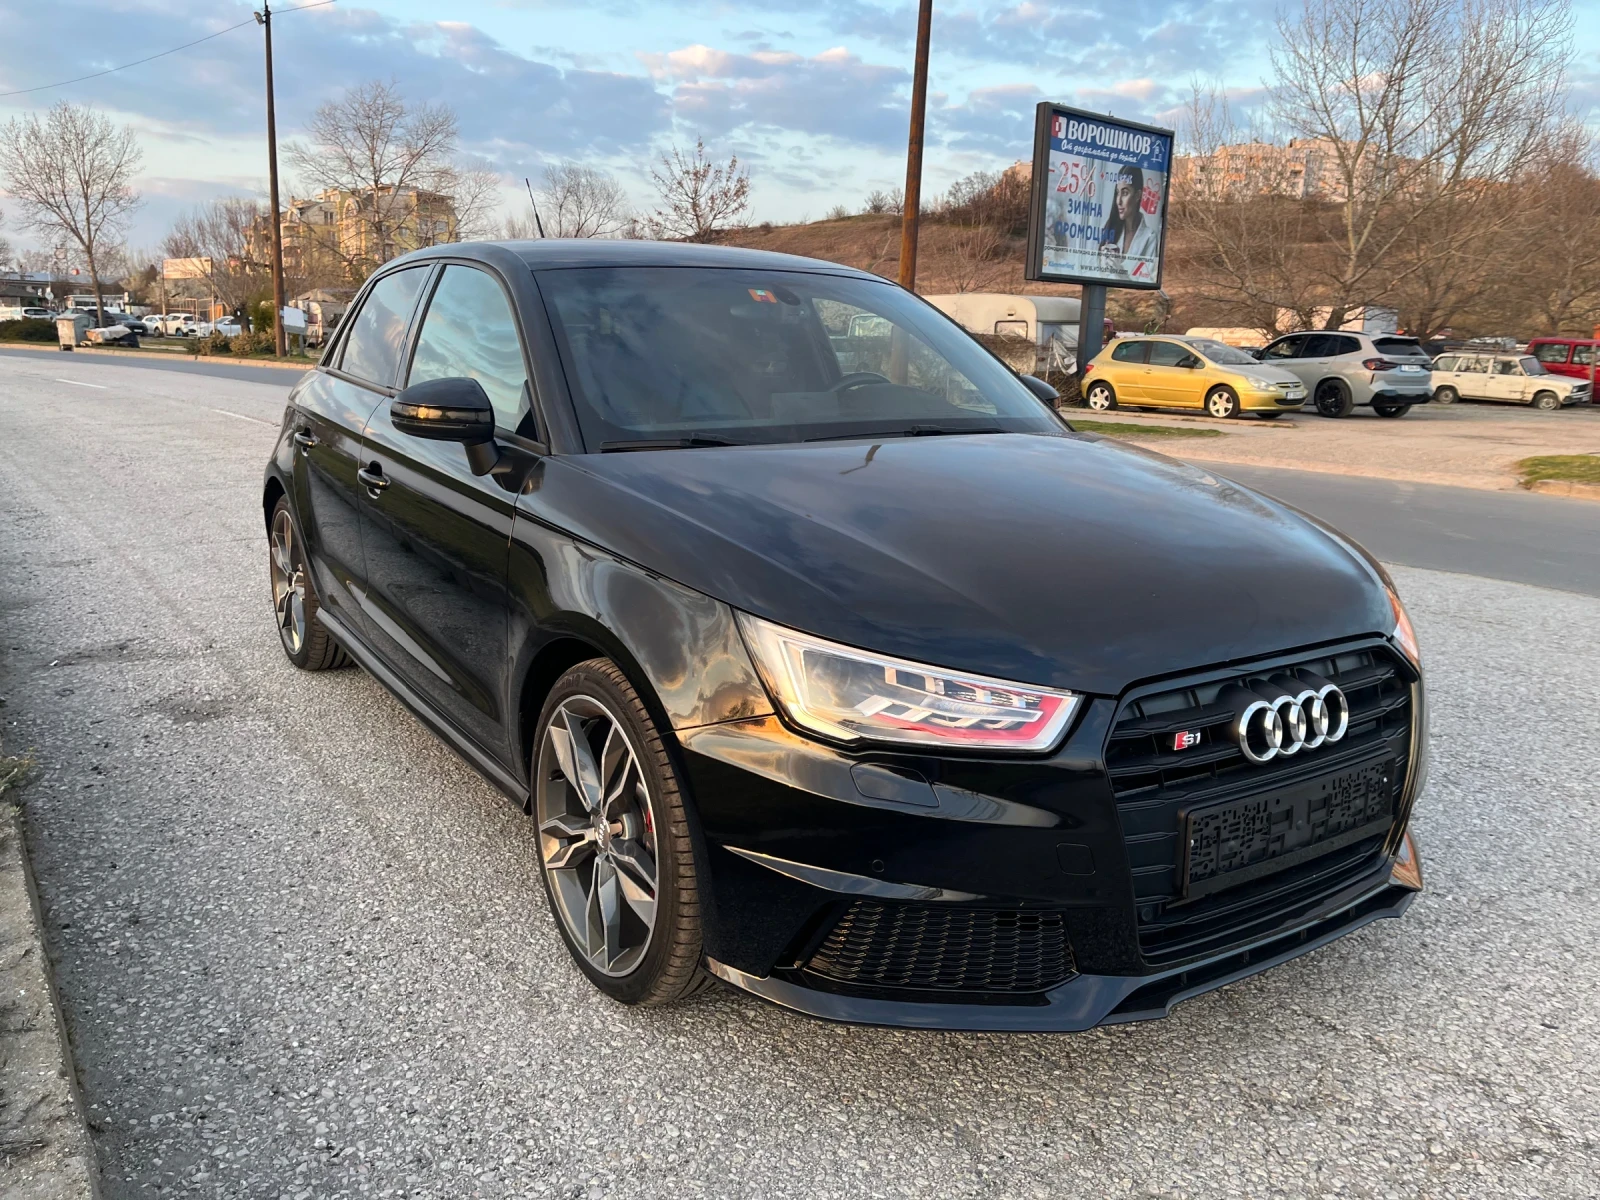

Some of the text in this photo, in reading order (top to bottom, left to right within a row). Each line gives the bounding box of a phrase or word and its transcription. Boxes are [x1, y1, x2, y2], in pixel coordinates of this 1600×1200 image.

[1068, 120, 1151, 155] ВОРОШИЛОВ
[1067, 198, 1103, 218] ЗИМНА
[1055, 221, 1116, 244] ПРОМОЦИЯ
[1181, 732, 1201, 745] S1
